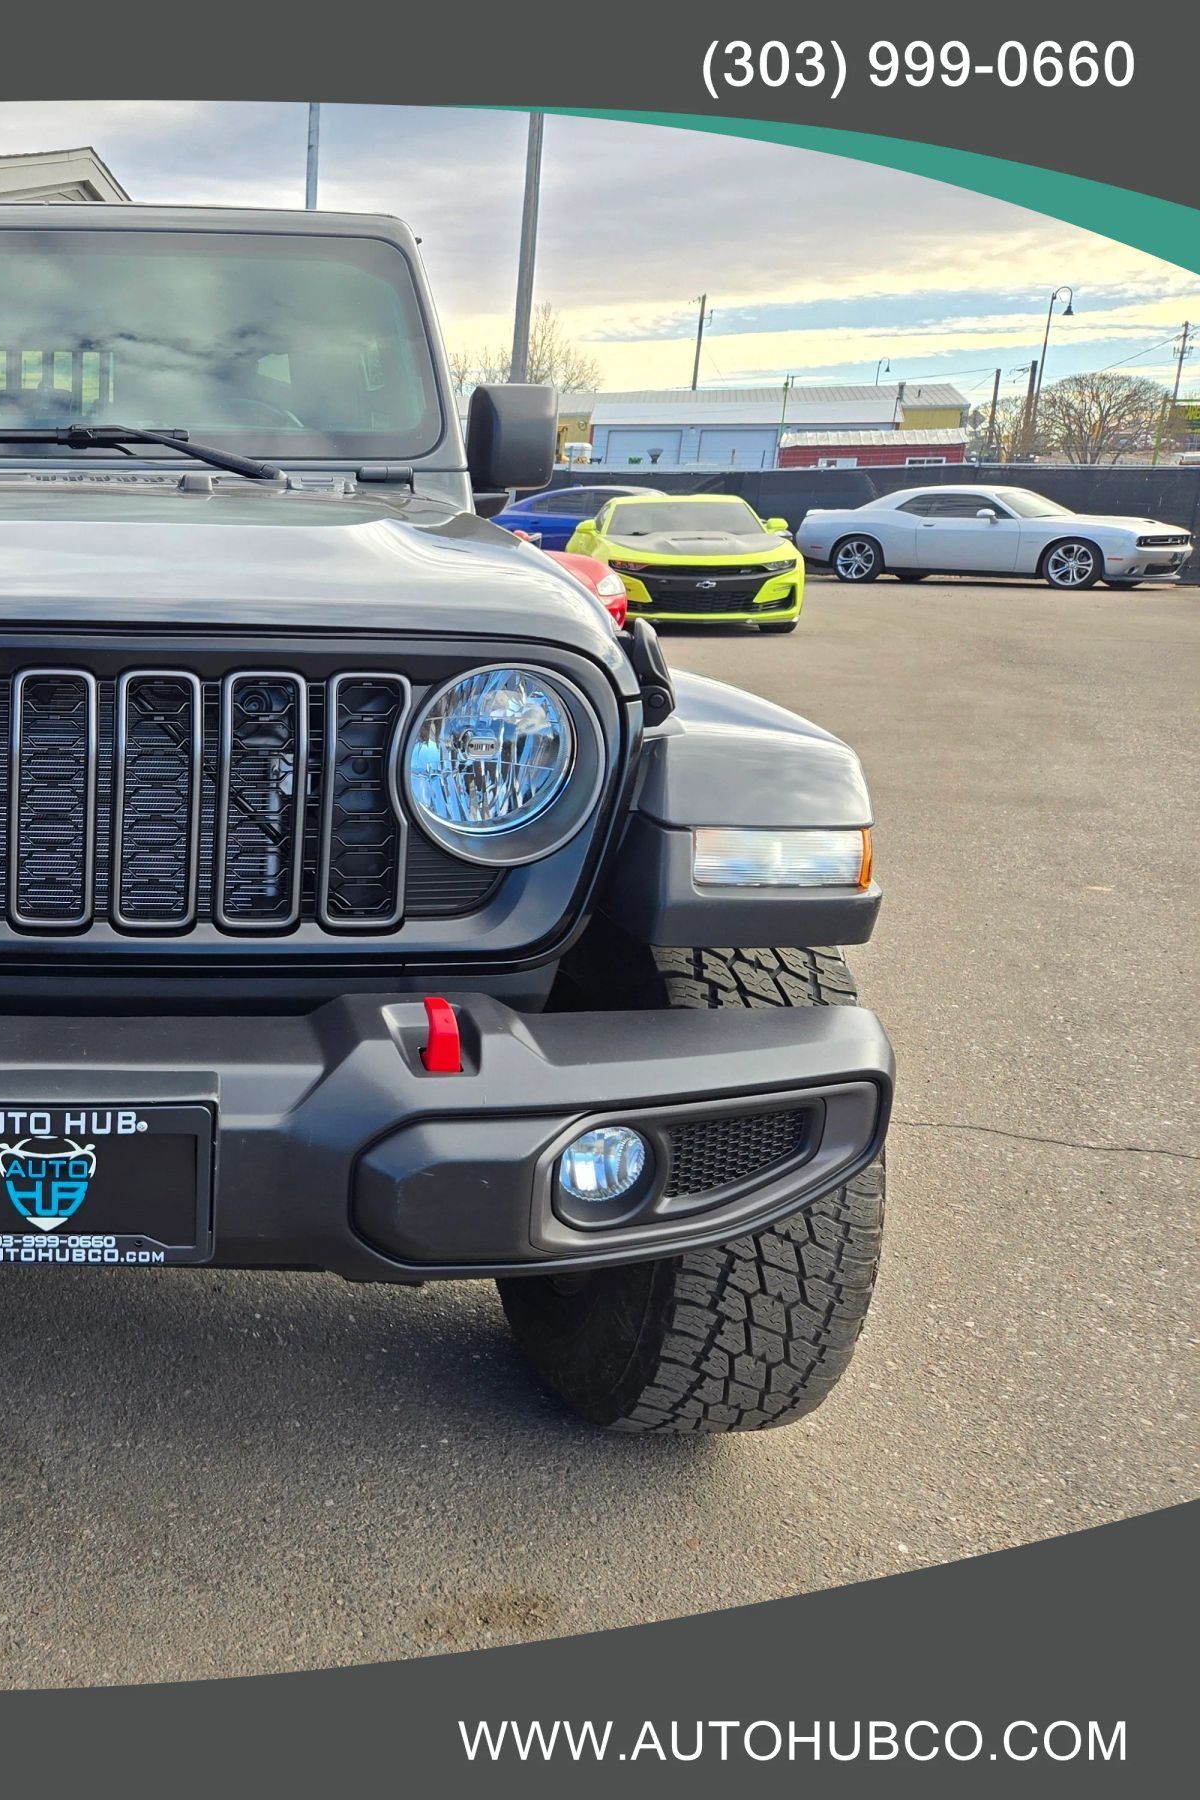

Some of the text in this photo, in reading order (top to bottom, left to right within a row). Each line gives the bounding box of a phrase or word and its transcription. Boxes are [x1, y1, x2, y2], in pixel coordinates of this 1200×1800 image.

[65, 1111, 137, 1135] HUB
[6, 1160, 88, 1179] AUTO
[5, 1180, 88, 1216] HUB
